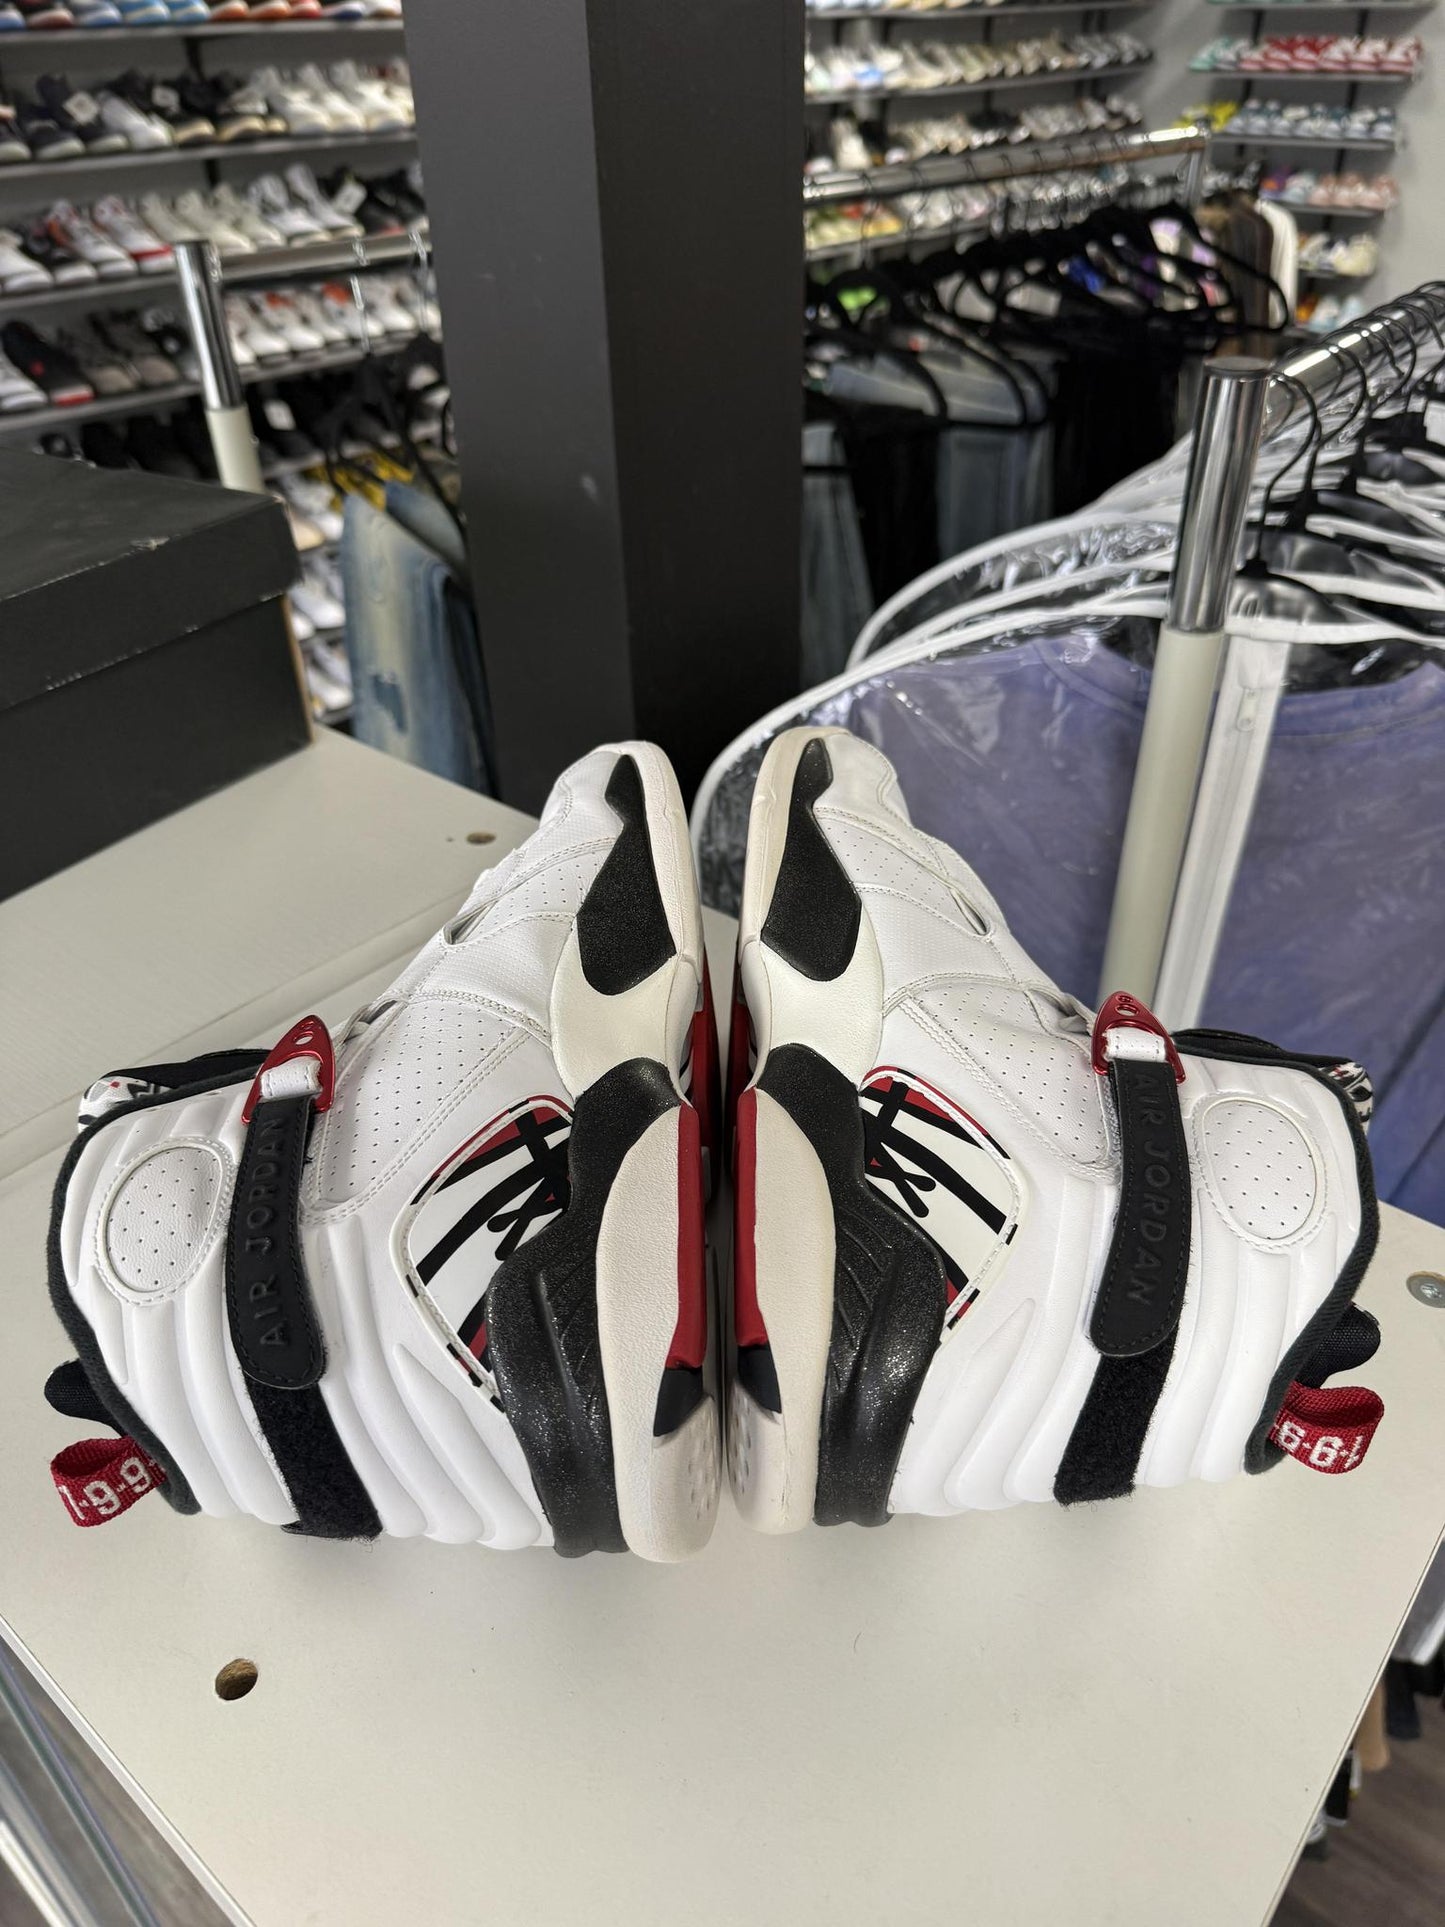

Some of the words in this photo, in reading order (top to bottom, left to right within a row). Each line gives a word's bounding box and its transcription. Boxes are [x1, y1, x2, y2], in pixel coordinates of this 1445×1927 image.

[1133, 1073, 1167, 1126] AIR
[245, 1118, 284, 1254] JORDAN
[1126, 1140, 1171, 1305] JORDAN
[250, 1273, 288, 1345] AIR
